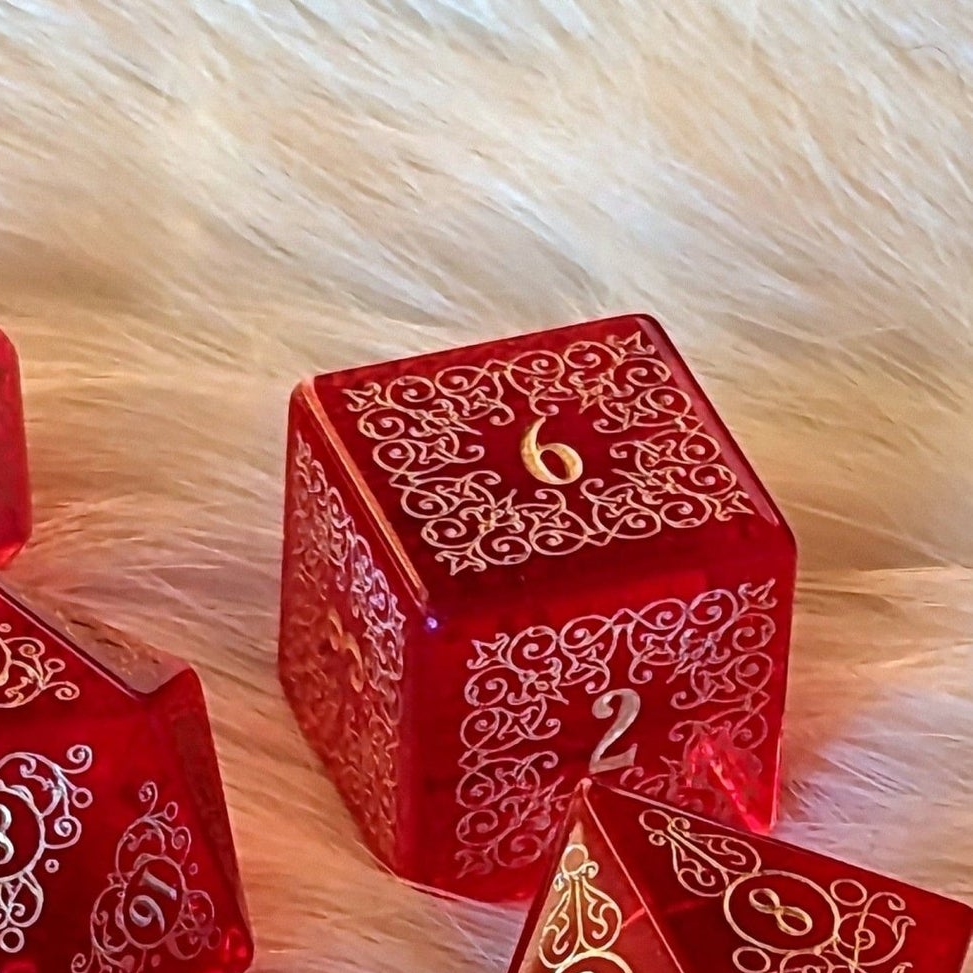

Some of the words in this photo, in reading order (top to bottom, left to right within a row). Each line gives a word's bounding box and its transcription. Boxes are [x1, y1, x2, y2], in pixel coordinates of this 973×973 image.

[520, 416, 583, 486] 6
[589, 688, 642, 775] 2
[748, 888, 814, 936] 8
